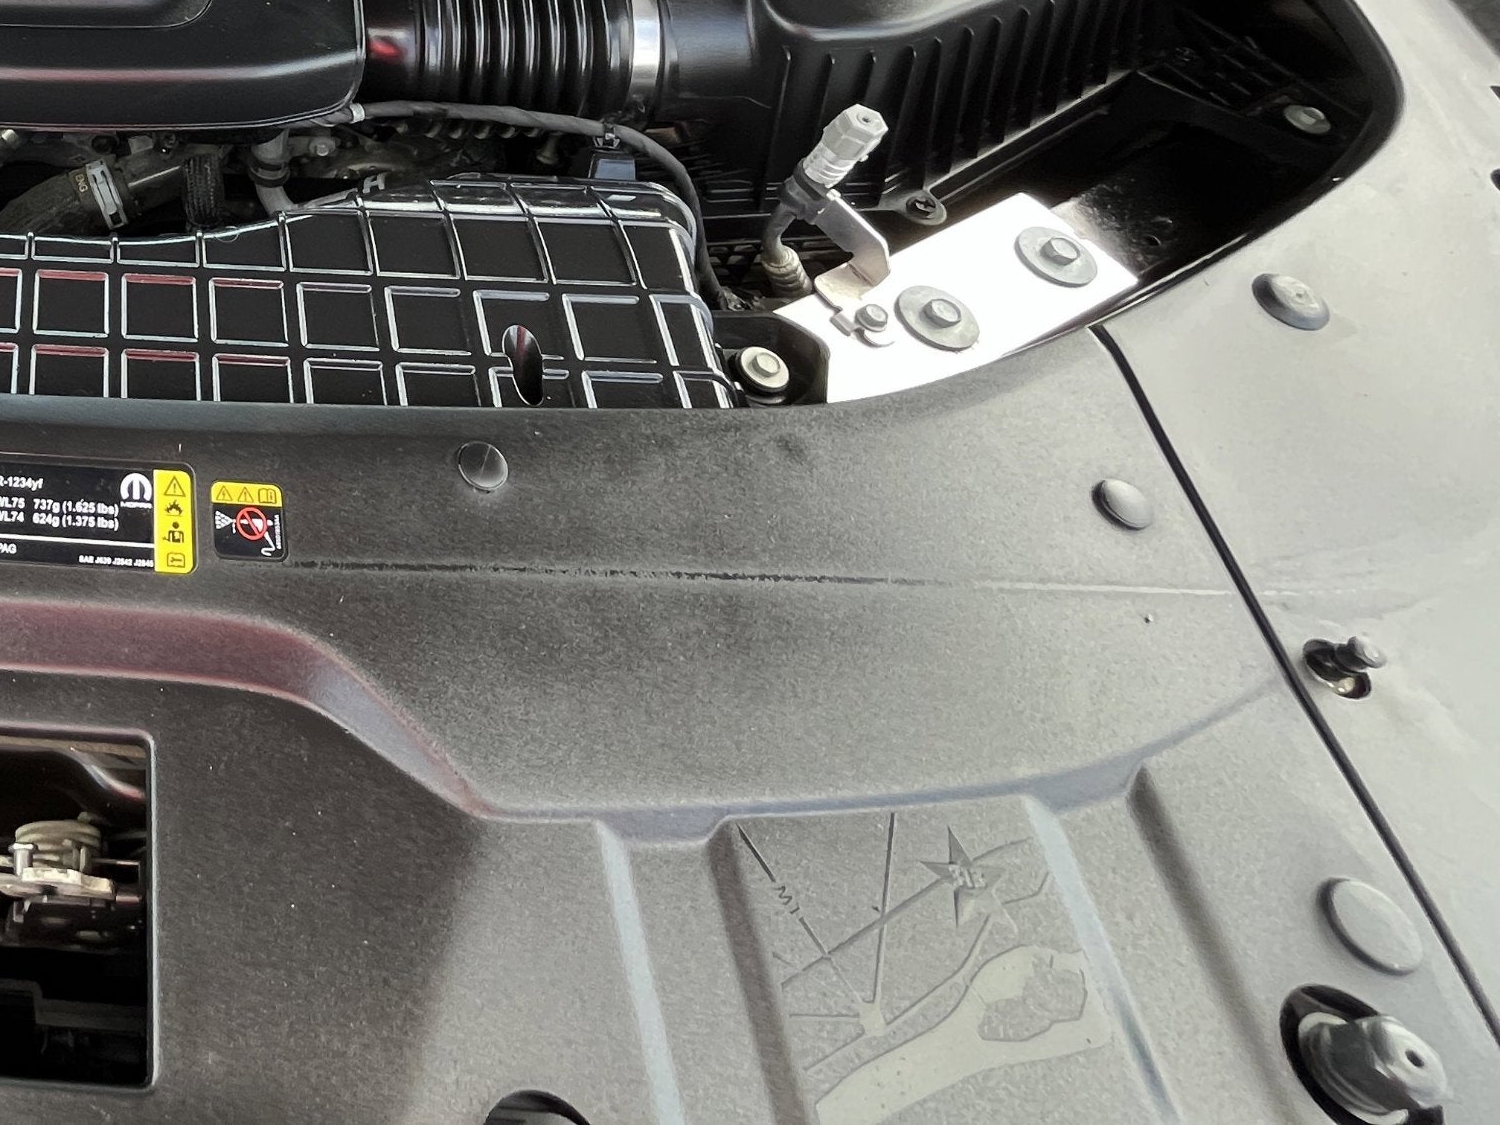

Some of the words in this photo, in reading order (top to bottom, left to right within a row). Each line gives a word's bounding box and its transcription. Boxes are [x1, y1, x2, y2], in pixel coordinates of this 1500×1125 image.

[33, 498, 61, 514] 737g
[62, 499, 96, 515] (1.625
[97, 502, 119, 518] lbs)
[32, 512, 60, 528] 624g
[62, 514, 96, 528] (1.375
[97, 516, 119, 531] lbs)
